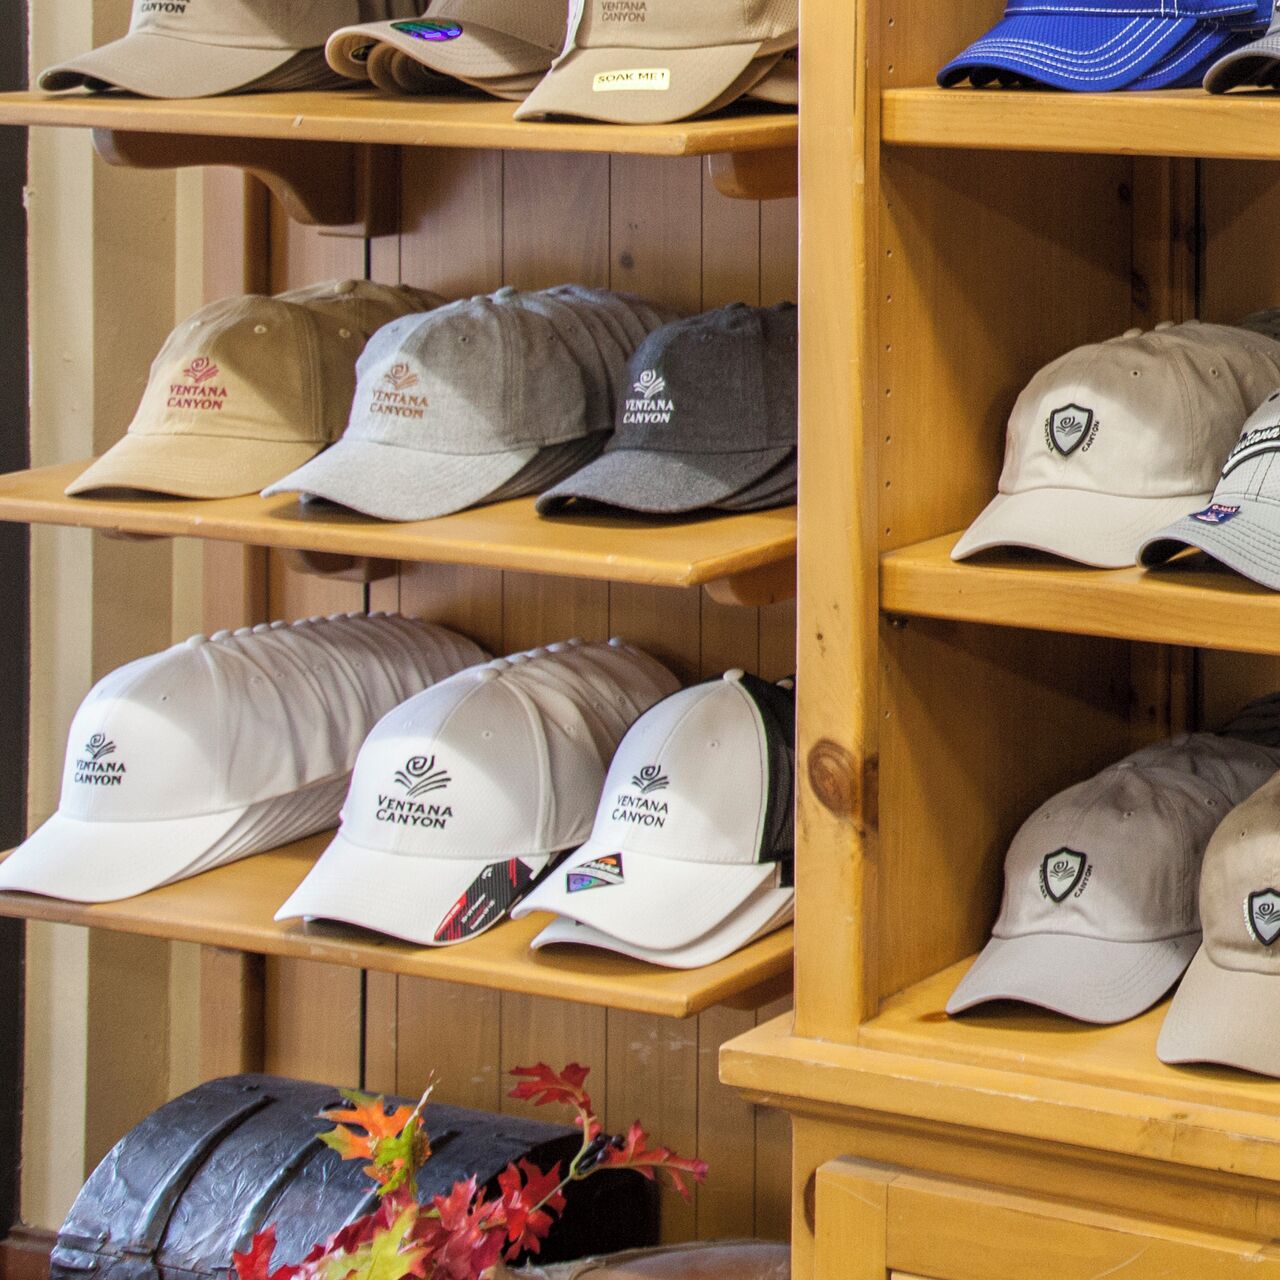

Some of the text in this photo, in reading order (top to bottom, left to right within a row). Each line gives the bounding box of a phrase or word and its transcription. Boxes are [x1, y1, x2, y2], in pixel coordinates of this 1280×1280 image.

[602, 1, 647, 12] VENTANA
[602, 11, 645, 23] CANYON
[598, 72, 634, 83] SOAK
[170, 384, 228, 398] VENTANA
[167, 397, 223, 410] CANYON
[370, 402, 424, 419] CANYON
[625, 398, 675, 412] VENTANA
[623, 412, 670, 424] CANYON
[75, 758, 126, 773] VENTANA
[74, 772, 122, 786] CANYON
[377, 795, 454, 818] VENTANA
[617, 795, 669, 814] VENTANA
[376, 810, 447, 830] CANYON
[612, 808, 666, 829] CANYON
